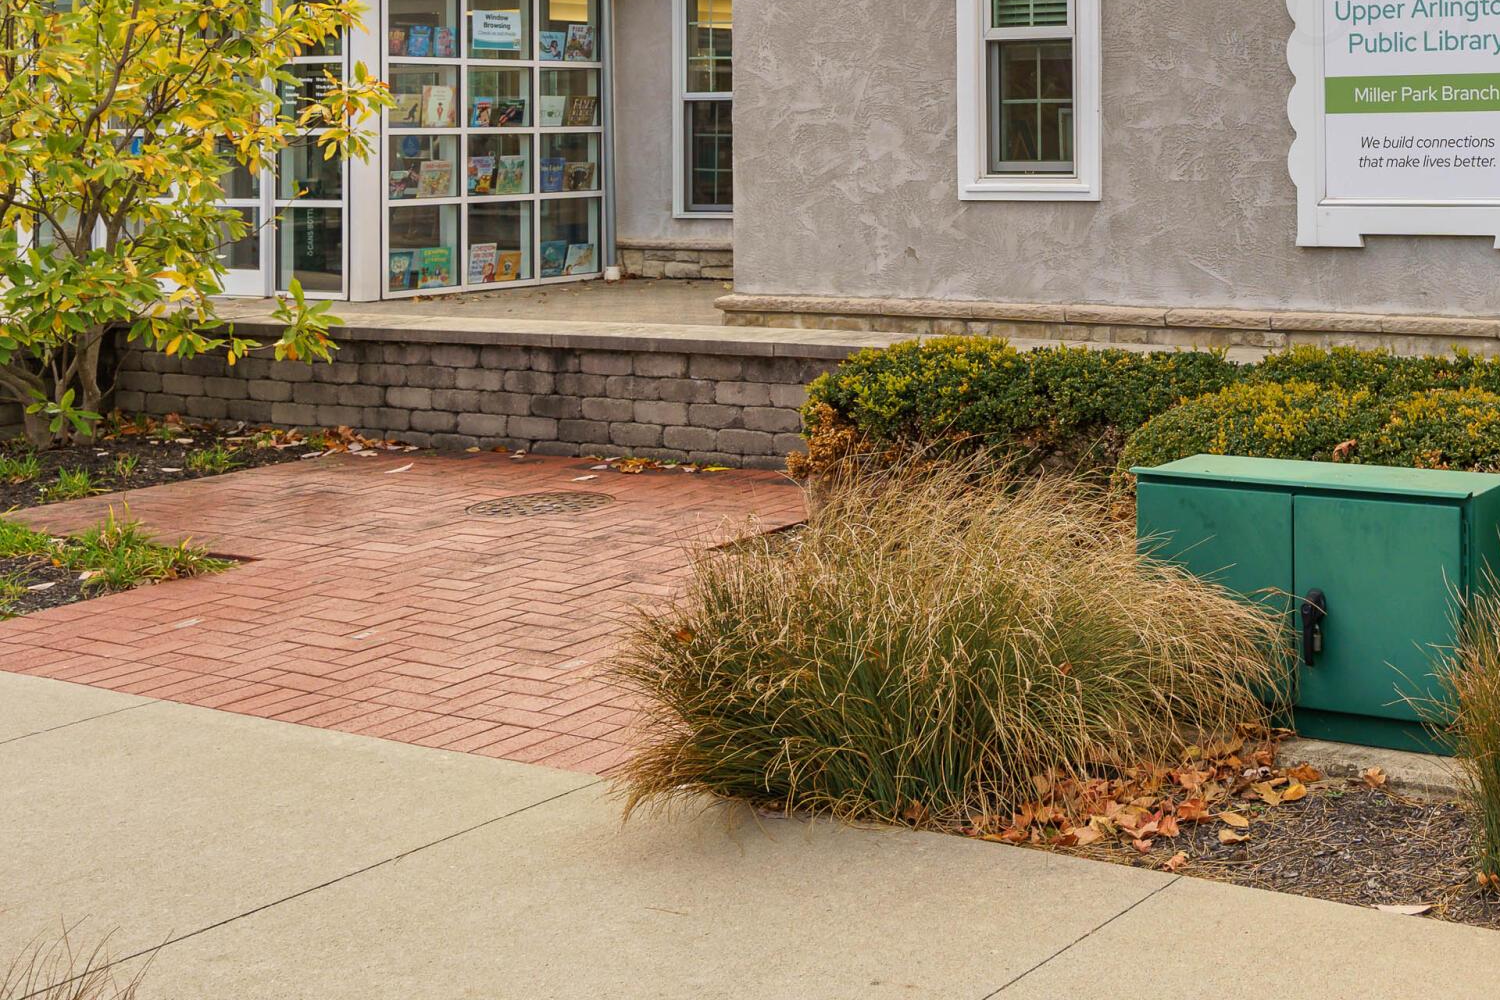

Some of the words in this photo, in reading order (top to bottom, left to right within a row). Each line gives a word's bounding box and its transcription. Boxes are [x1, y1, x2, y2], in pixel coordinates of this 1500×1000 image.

[1335, 0, 1405, 26] Upper
[483, 21, 511, 30] Browsing
[1349, 31, 1417, 54] Public
[1354, 87, 1397, 102] Miller
[1401, 86, 1438, 102] Park
[1442, 84, 1500, 101] Branch
[1360, 136, 1380, 149] We
[1383, 135, 1414, 149] build
[1416, 135, 1495, 148] connections
[1358, 155, 1384, 168] that
[1386, 155, 1420, 168] make
[1423, 155, 1451, 168] lives
[1453, 154, 1496, 168] better.
